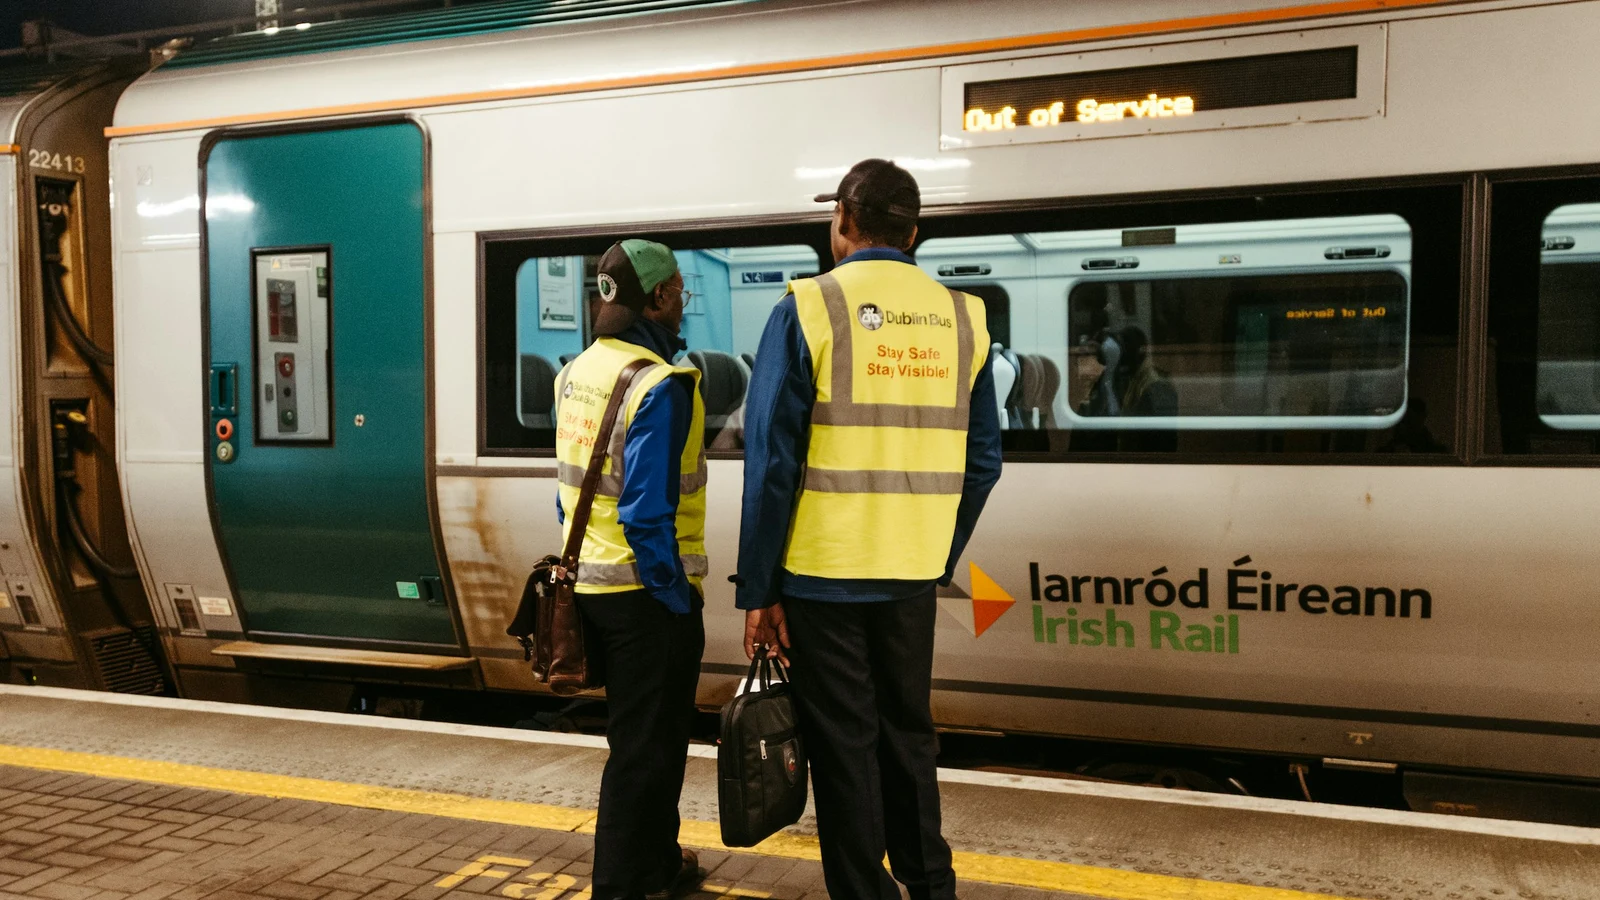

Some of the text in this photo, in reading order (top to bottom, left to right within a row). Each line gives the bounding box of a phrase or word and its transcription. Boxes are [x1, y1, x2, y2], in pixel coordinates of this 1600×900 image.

[965, 93, 1194, 132] Out of Service
[29, 148, 85, 174] 22413
[885, 310, 952, 328] Dublin Bus
[877, 344, 941, 362] Stay Safe
[867, 362, 950, 379] Stay Visible!
[1029, 554, 1432, 619] Iarnród Éireann
[1032, 604, 1240, 654] Irish Rail
